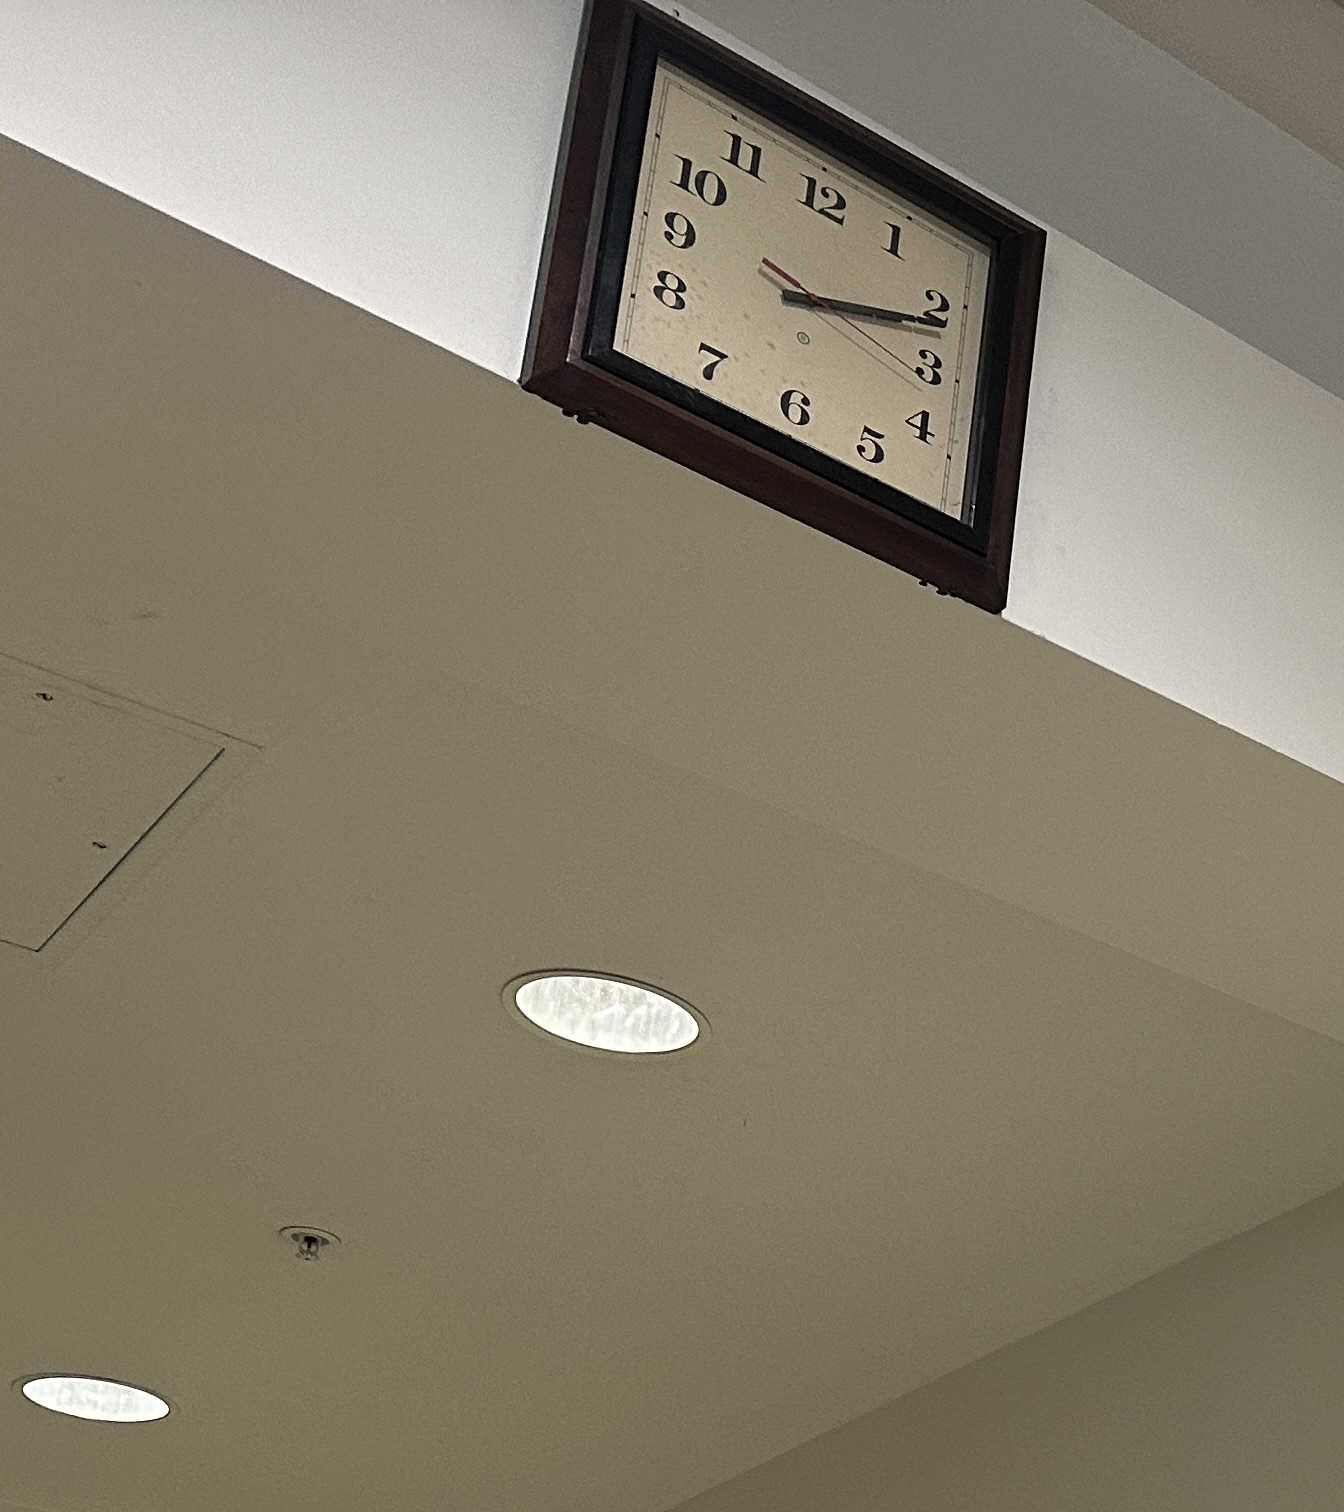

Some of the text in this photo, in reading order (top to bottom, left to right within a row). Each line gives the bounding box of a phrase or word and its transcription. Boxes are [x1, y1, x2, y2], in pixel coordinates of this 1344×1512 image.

[722, 130, 766, 182] 11
[671, 154, 727, 207] 10
[797, 173, 847, 224] 12
[663, 212, 697, 248] 9
[882, 222, 905, 260] 1
[653, 271, 688, 311] 8
[922, 289, 951, 328] 2
[697, 343, 729, 381] 7
[915, 349, 943, 386] 3
[780, 390, 812, 426] 6
[904, 410, 936, 444] 4
[856, 427, 886, 464] 5
